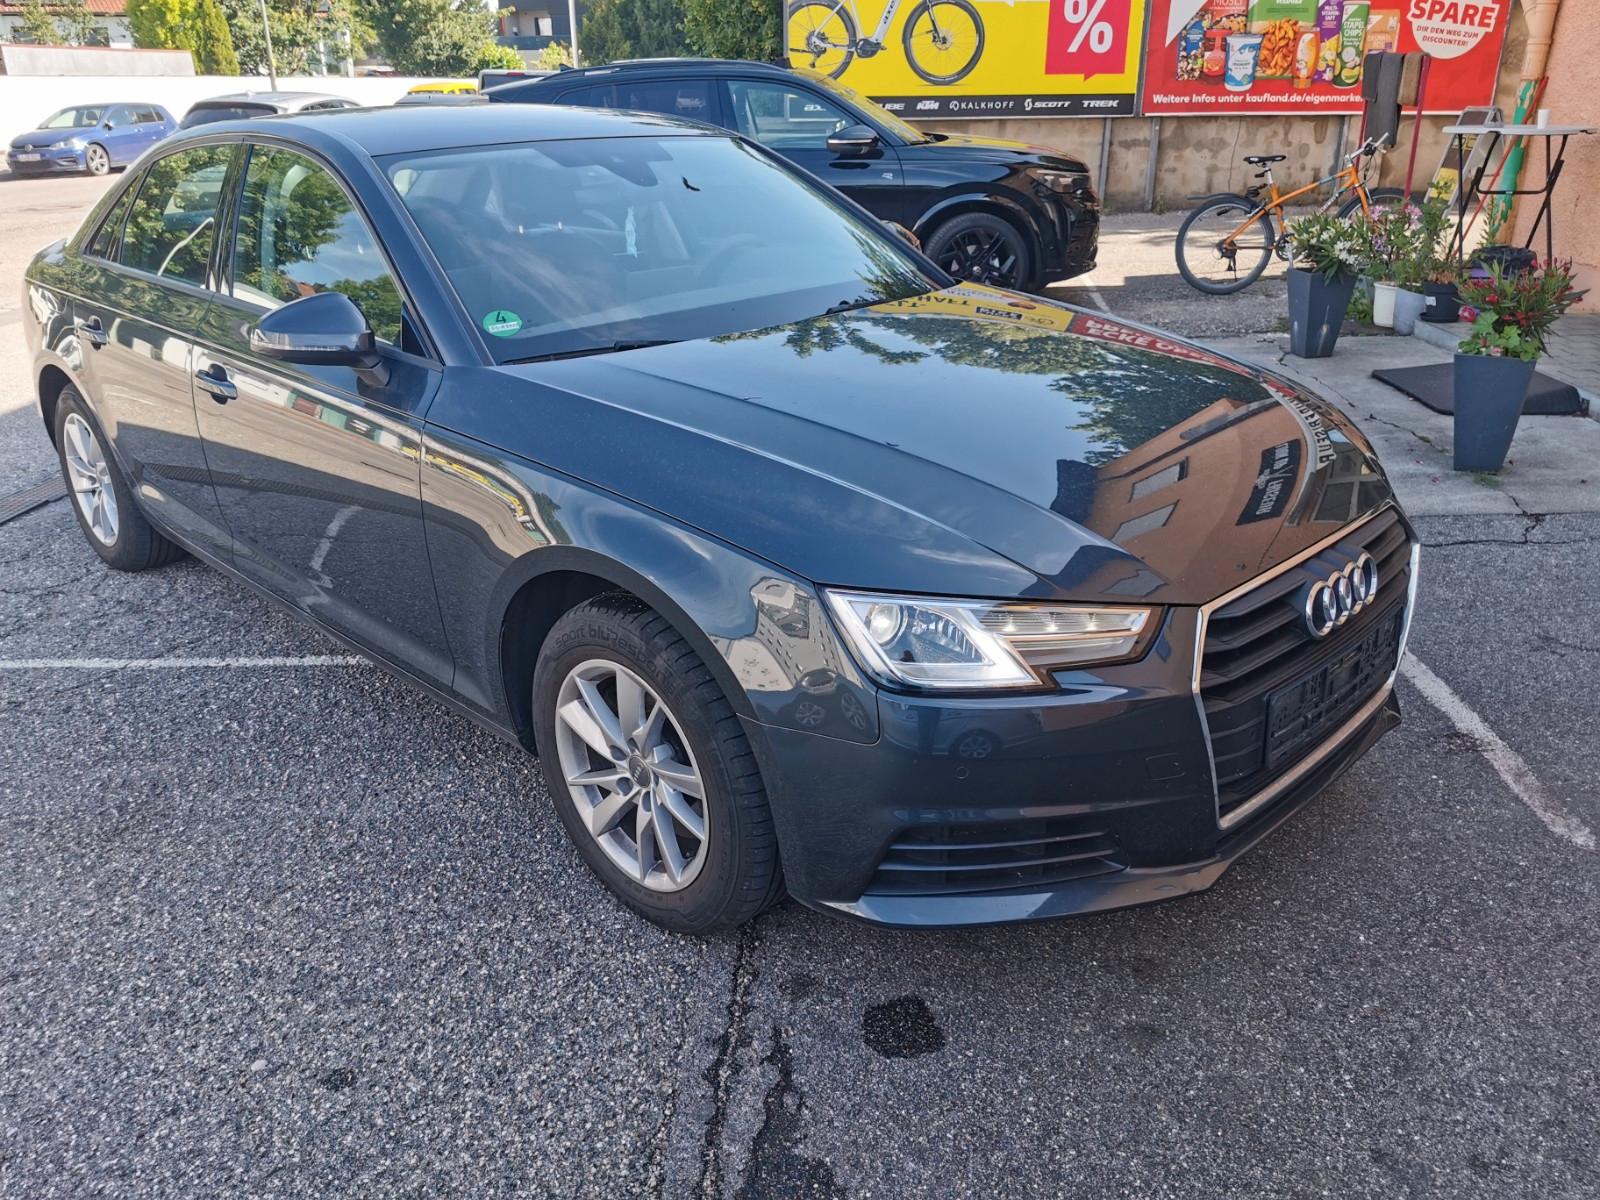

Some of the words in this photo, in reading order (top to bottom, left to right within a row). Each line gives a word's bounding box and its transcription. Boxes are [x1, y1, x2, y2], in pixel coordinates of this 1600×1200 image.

[1411, 0, 1496, 29] SPARE
[1416, 25, 1429, 33] DIR
[1430, 27, 1445, 35] DEN
[1446, 29, 1461, 37] WEG
[1462, 31, 1479, 39] ZUM
[916, 100, 940, 110] KTM
[960, 101, 1015, 110] KALKHOFF
[1081, 100, 1120, 108] TREK
[1152, 93, 1190, 104] Weitere
[1192, 93, 1216, 104] Infos
[1217, 94, 1244, 103] unter
[1246, 93, 1363, 105] kaufland.de/eigenmarke
[495, 311, 507, 324] 4
